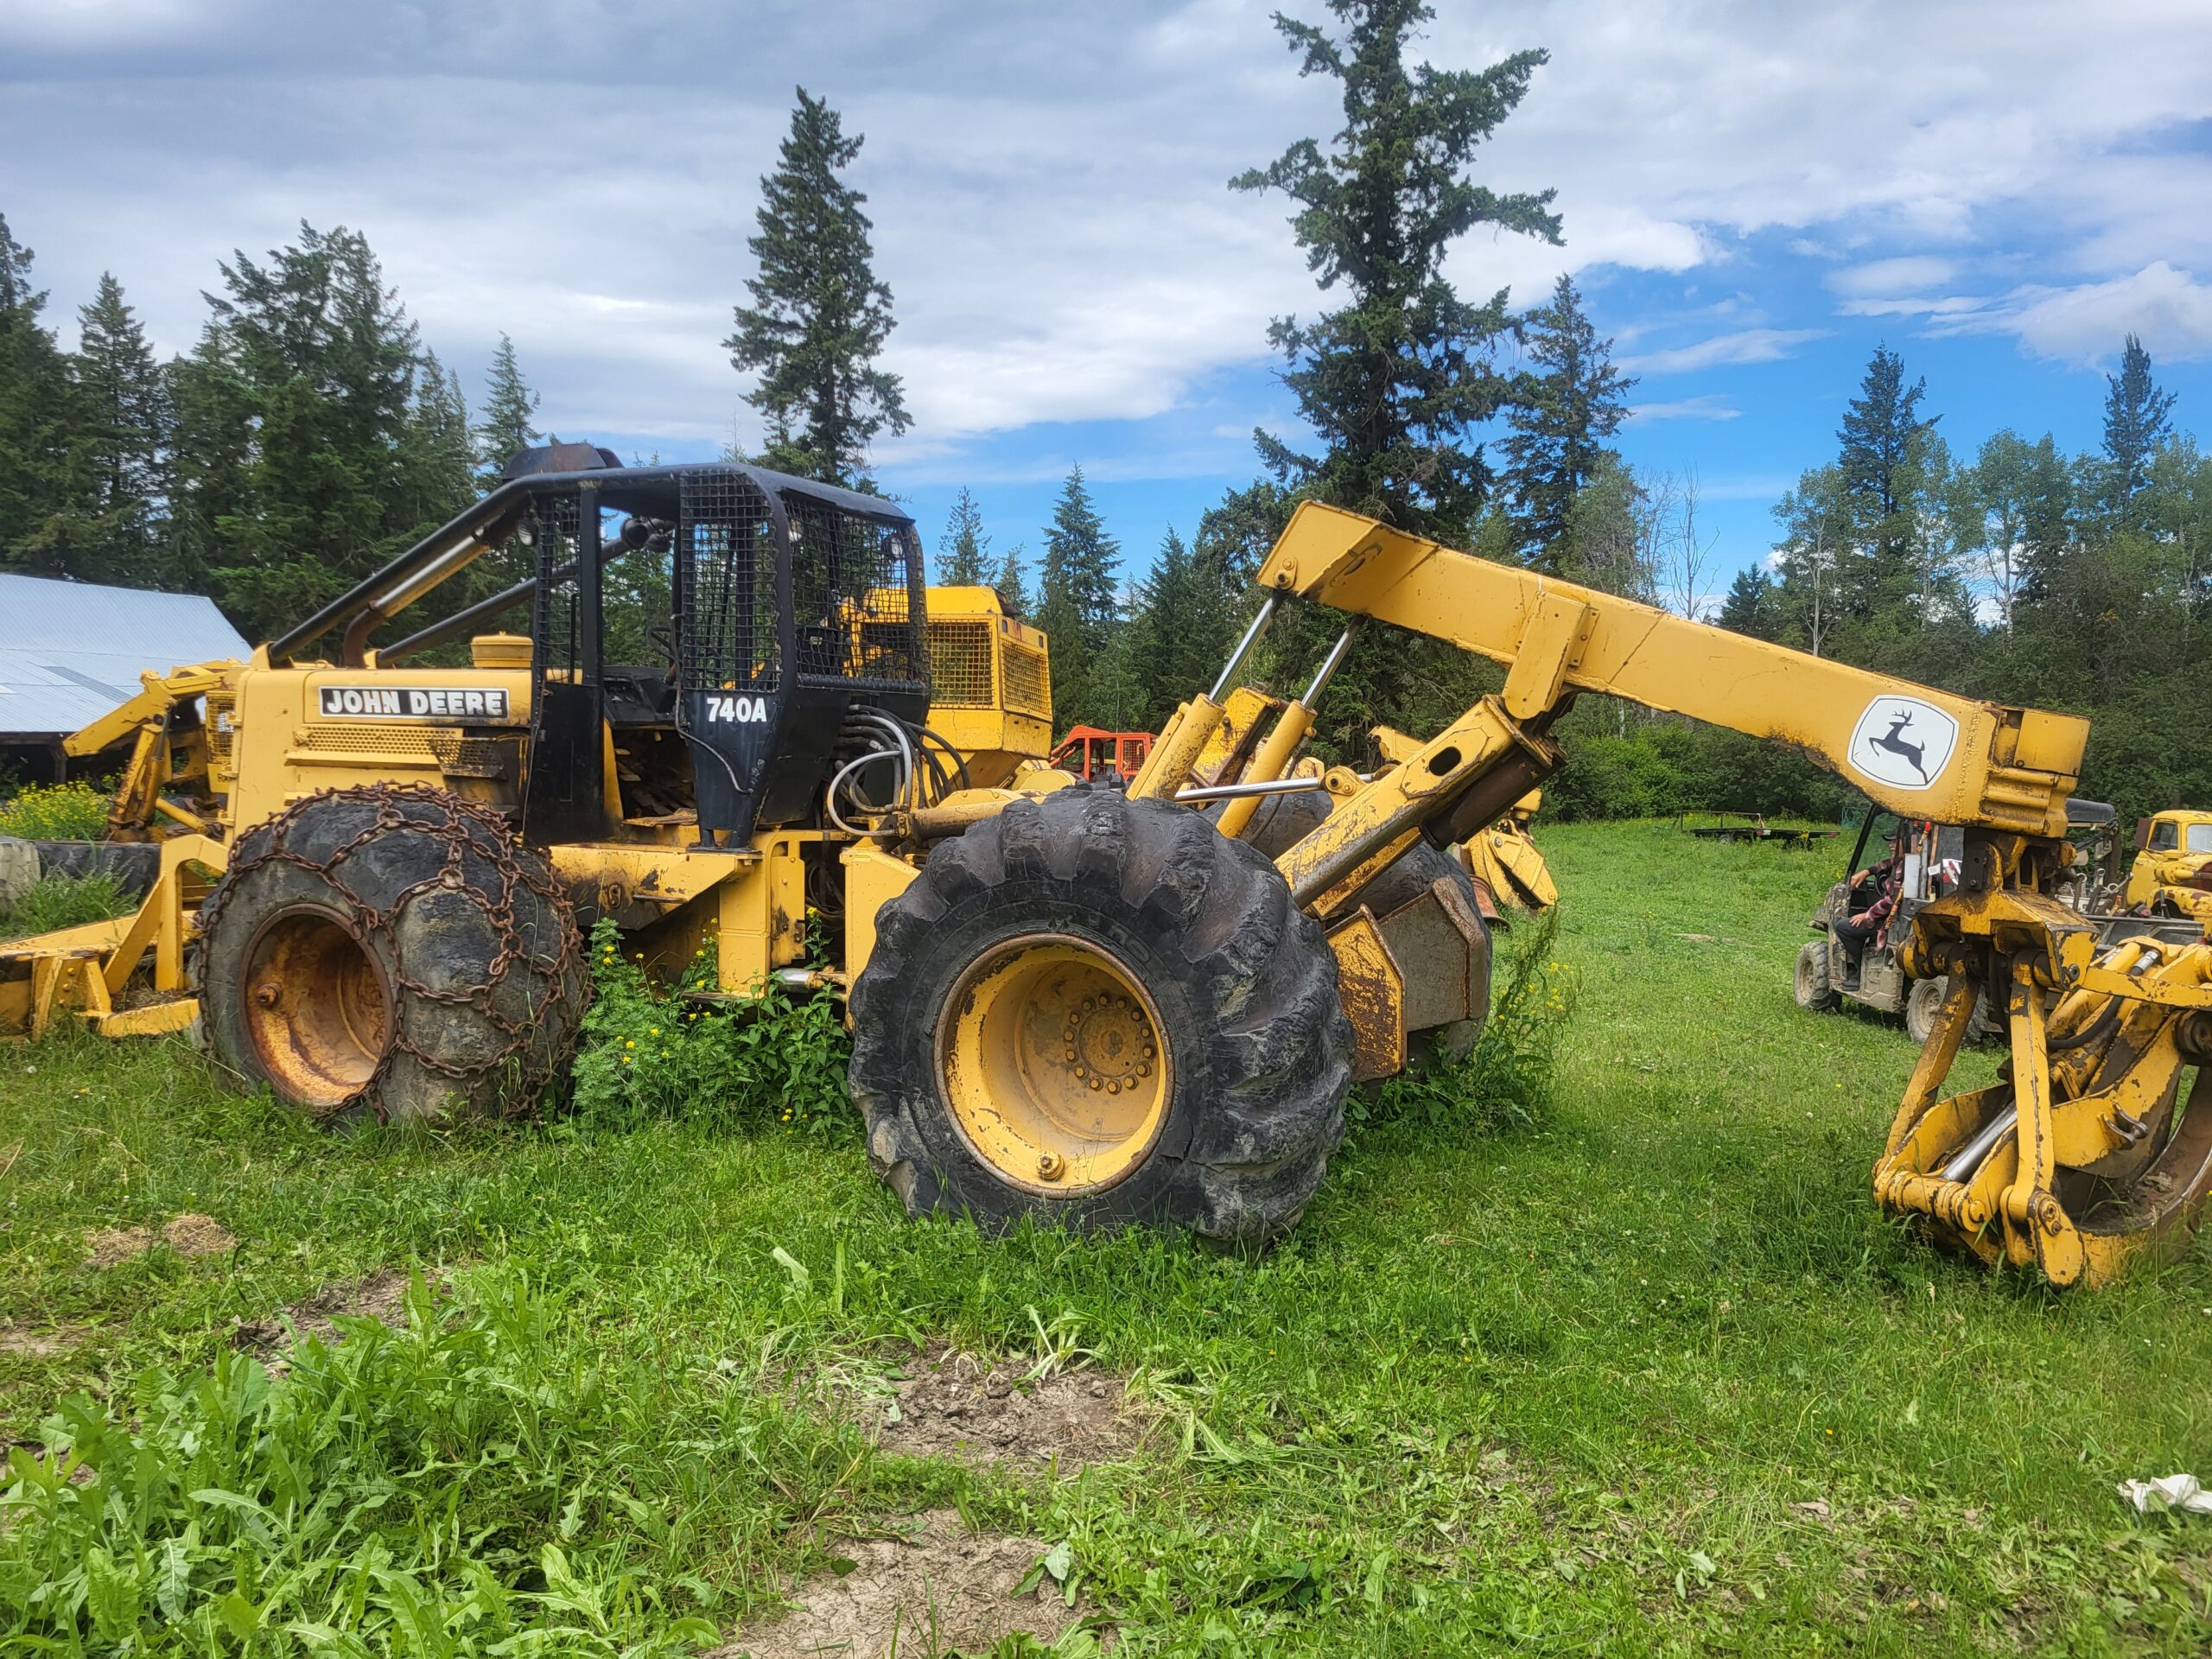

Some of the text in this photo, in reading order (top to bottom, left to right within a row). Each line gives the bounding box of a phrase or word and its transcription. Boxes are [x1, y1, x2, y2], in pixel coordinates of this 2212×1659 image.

[327, 690, 503, 716] JOHN DEERE
[707, 696, 767, 723] 740A
